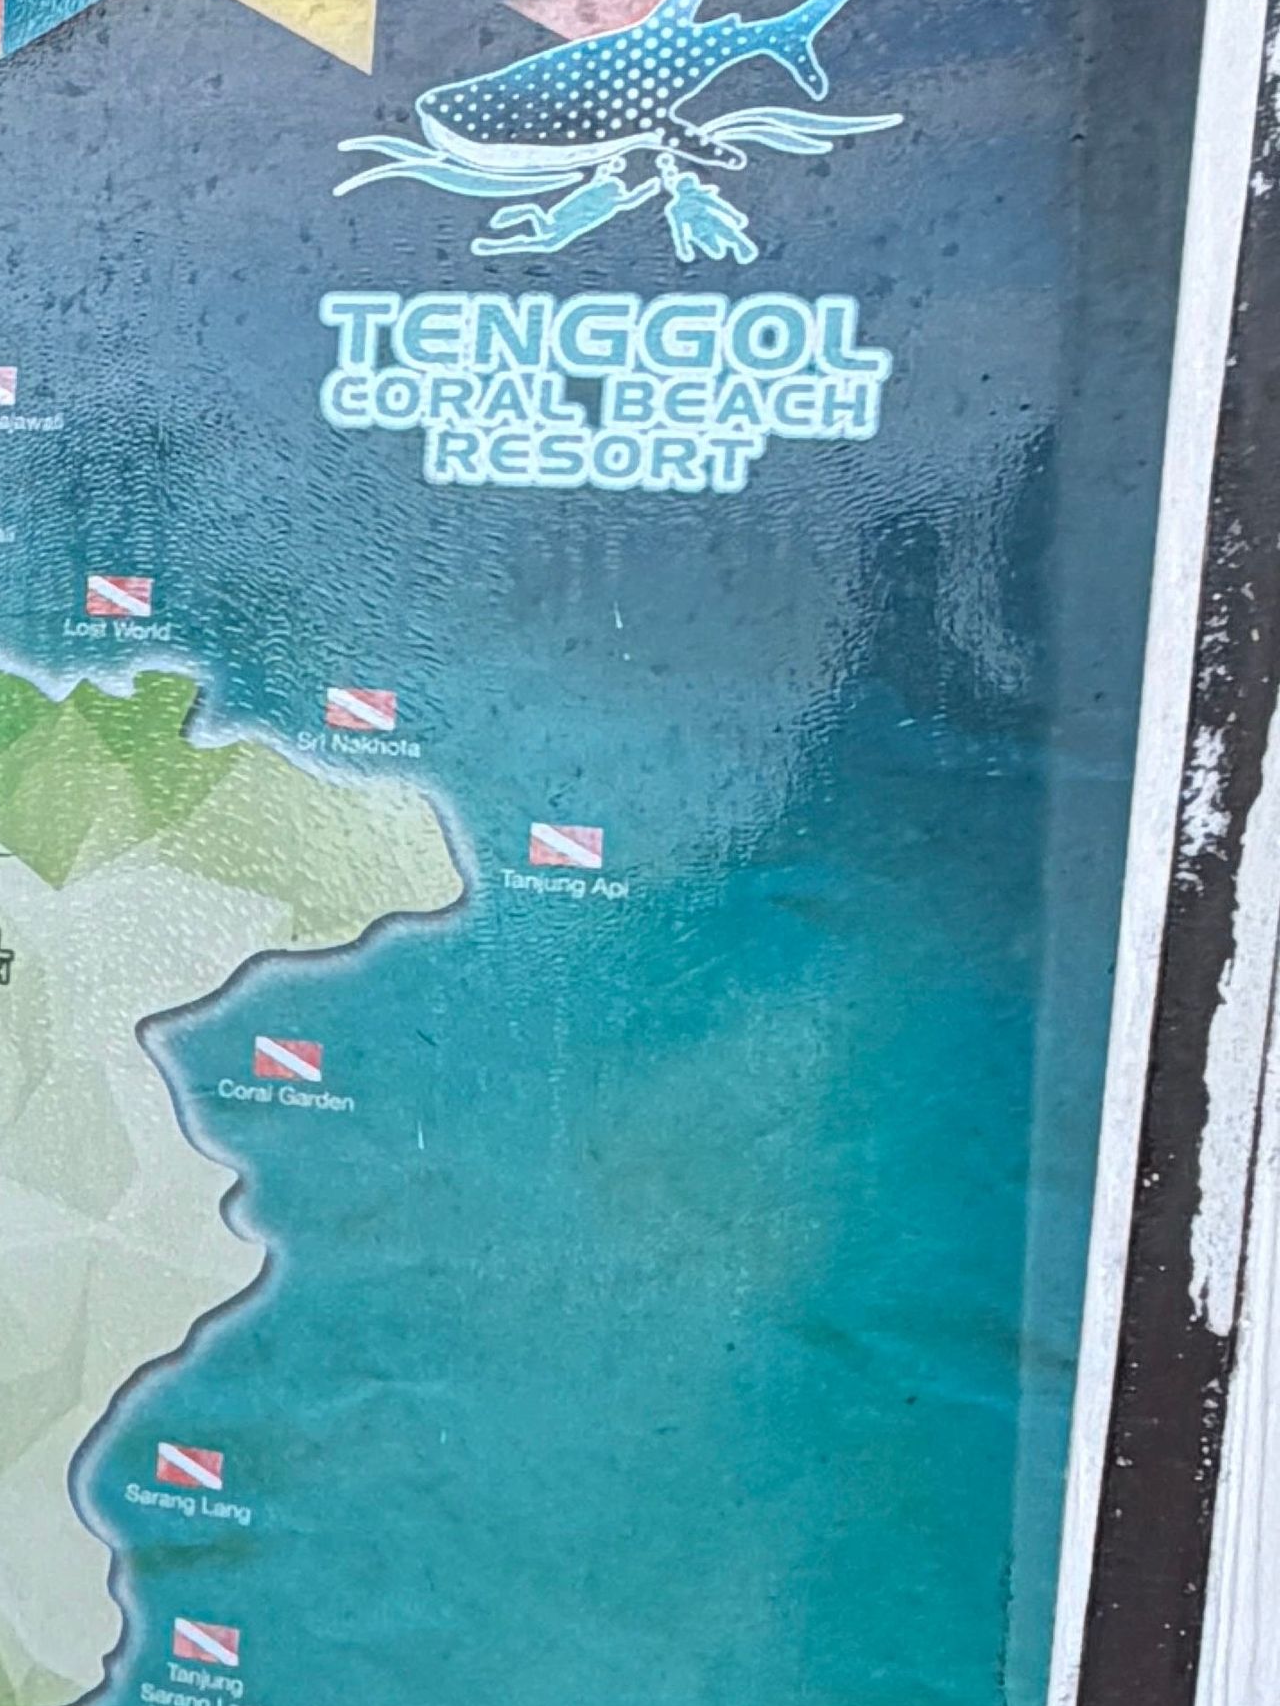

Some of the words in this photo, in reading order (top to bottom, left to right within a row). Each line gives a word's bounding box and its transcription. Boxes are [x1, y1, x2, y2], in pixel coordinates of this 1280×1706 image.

[320, 293, 892, 378] TENGGOL
[321, 369, 585, 430] CORAL
[601, 373, 881, 440] BEACH
[424, 427, 767, 493] RESORT
[63, 618, 112, 638] Lost
[113, 619, 172, 643] World
[296, 730, 326, 752] Sri
[500, 867, 586, 899] Tanjung
[591, 878, 630, 900] Api
[217, 1077, 273, 1104] Coral
[278, 1085, 355, 1113] Garden
[124, 1482, 196, 1517] Sarang
[200, 1495, 252, 1526] Lang
[166, 1661, 244, 1697] Tanjung
